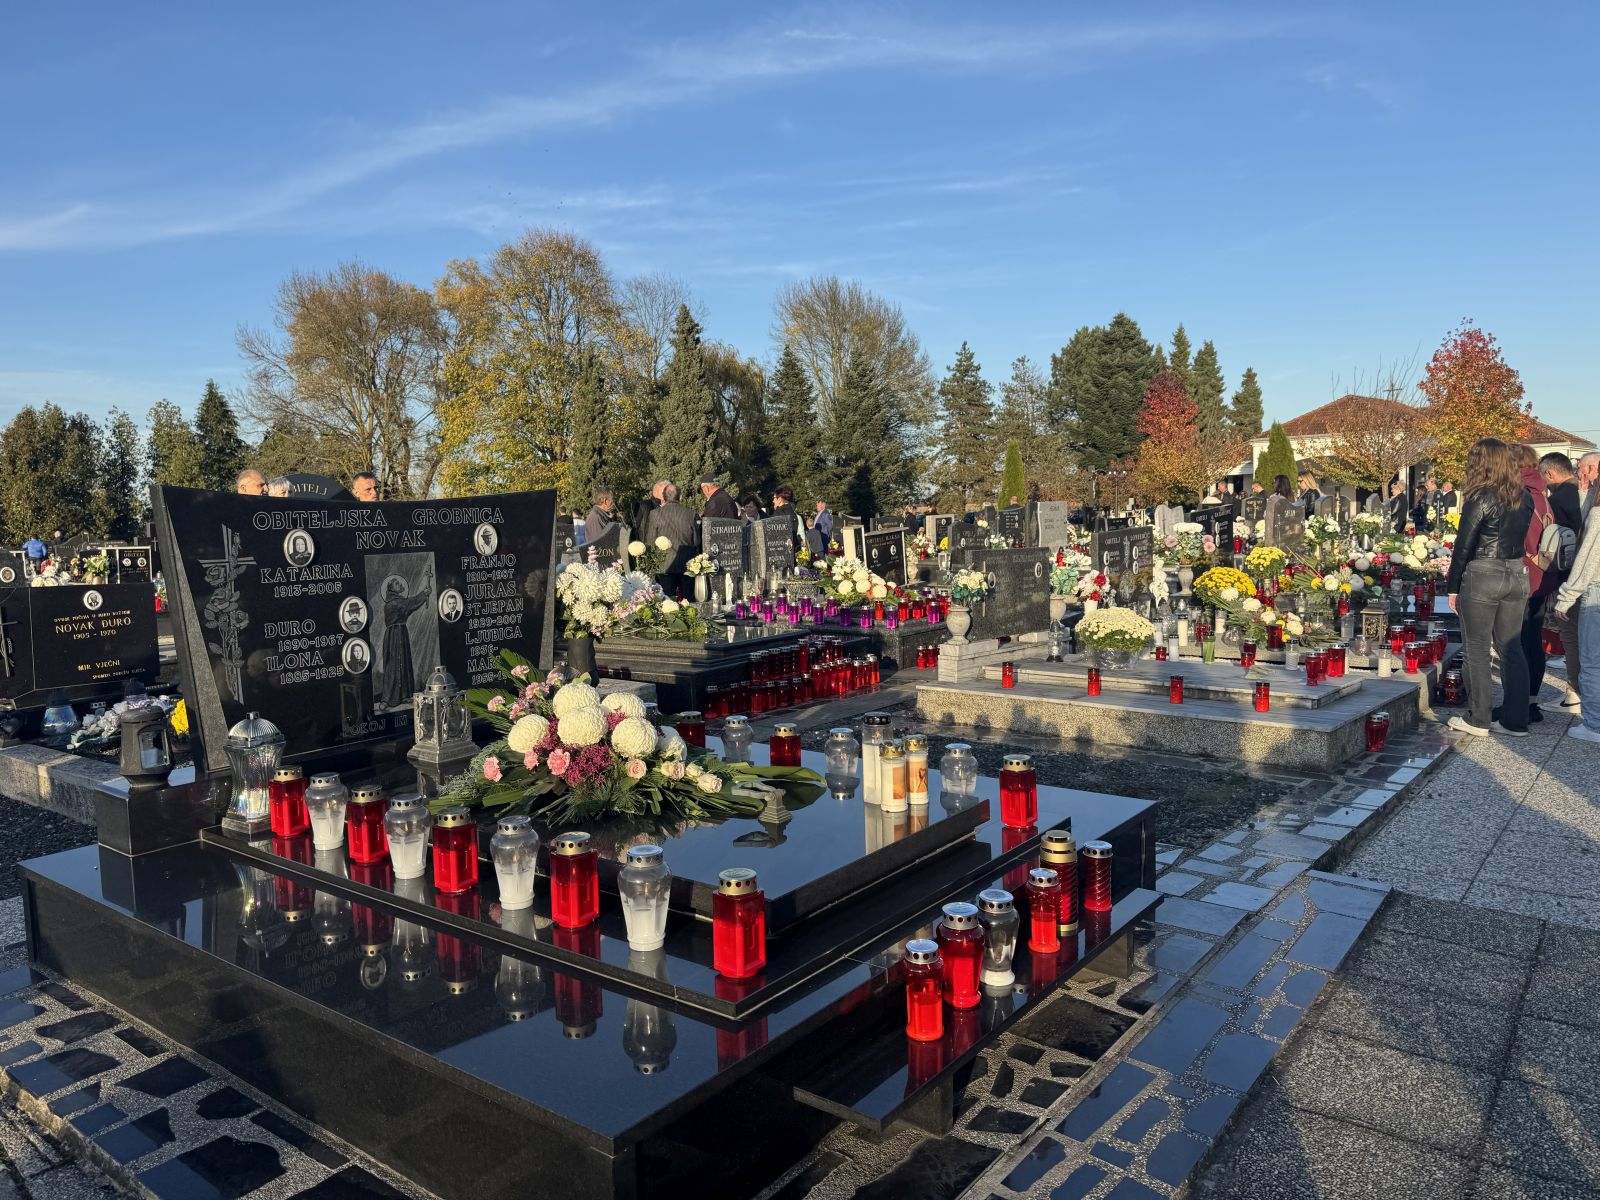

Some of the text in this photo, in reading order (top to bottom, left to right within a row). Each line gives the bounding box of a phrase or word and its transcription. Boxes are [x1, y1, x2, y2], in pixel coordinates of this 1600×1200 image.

[252, 507, 505, 531] OBITELJSKA GROBNICA
[355, 529, 427, 549] NOVAK
[461, 553, 517, 570] FRANJO
[260, 563, 354, 584] KATARINA
[274, 582, 343, 598] 1913-2005
[464, 598, 524, 617] STJEPAN
[55, 621, 95, 634] NOVAK
[100, 629, 117, 637] 1970
[465, 626, 523, 645] LJUBICA
[278, 634, 345, 652] 1890-1967
[77, 664, 92, 672] MIR
[266, 651, 324, 672] ILONA
